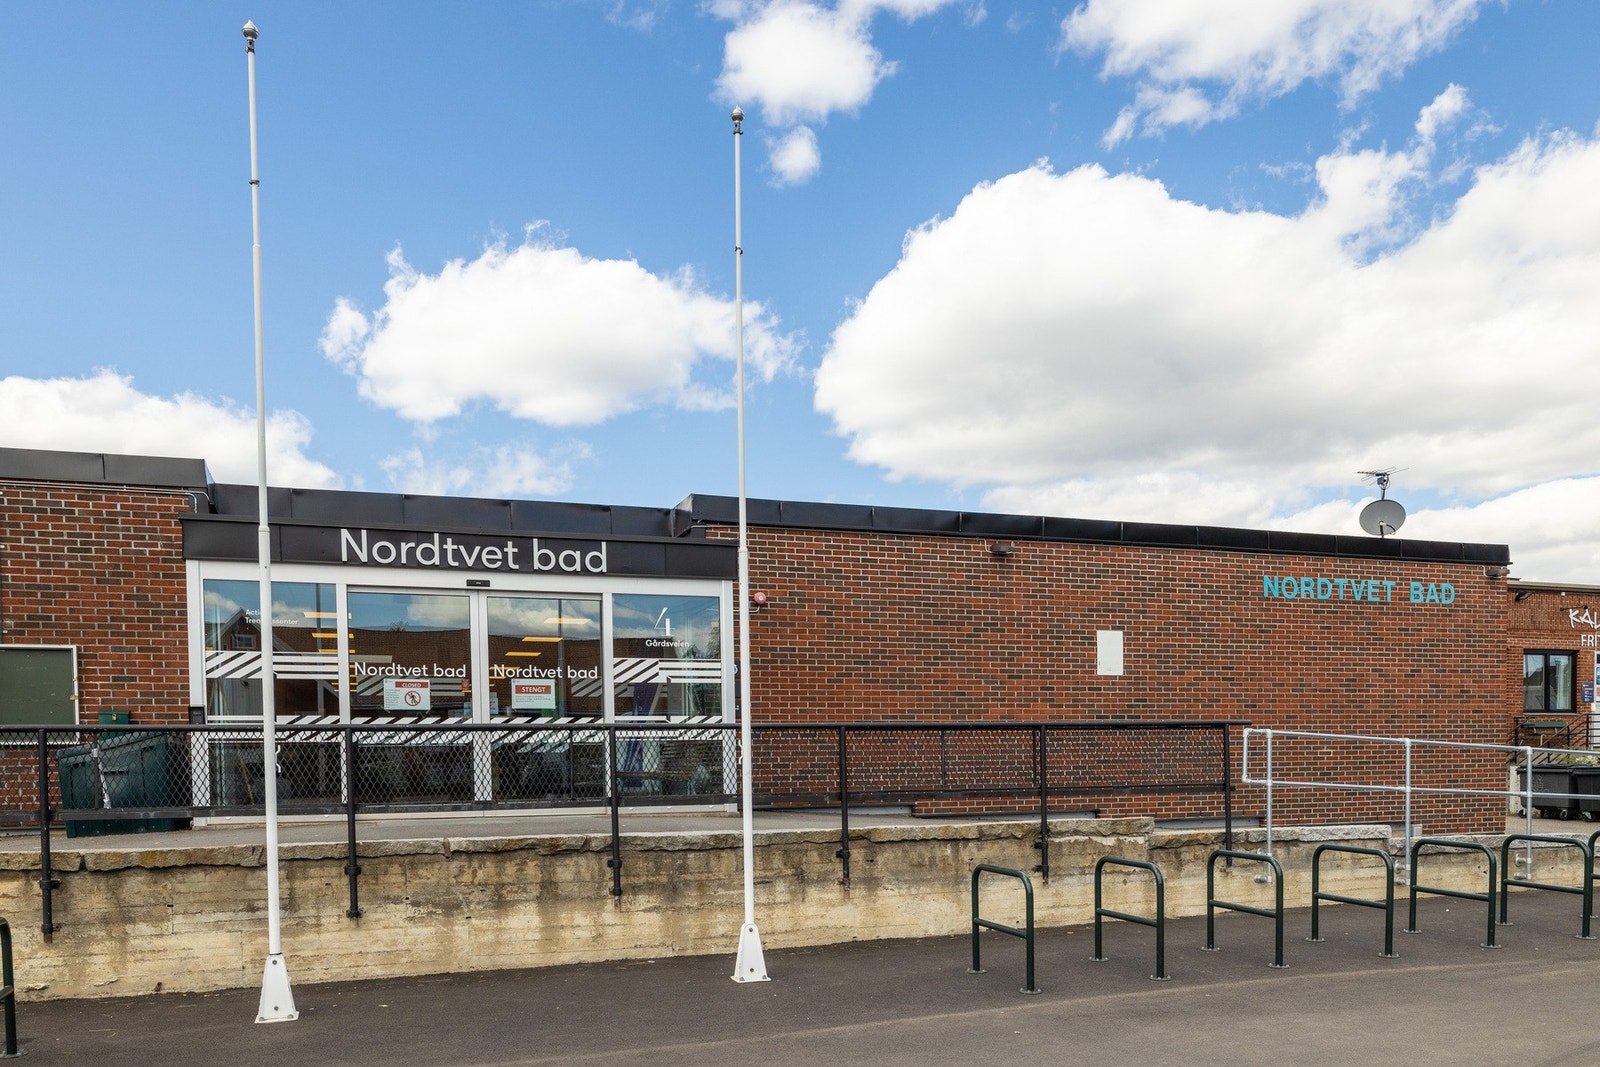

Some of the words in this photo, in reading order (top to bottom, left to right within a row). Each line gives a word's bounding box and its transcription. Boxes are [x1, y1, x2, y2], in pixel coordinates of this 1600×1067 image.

[340, 528, 519, 570] Nordtvet
[532, 538, 608, 573] bad
[1263, 575, 1396, 603] NORDTVET
[1409, 582, 1456, 605] BAD
[654, 607, 675, 637] 4
[645, 639, 690, 648] Gårdsveien
[354, 662, 428, 677] Nordtvet
[433, 663, 466, 678] bad
[493, 664, 563, 678] Nordtvet
[567, 666, 598, 679] bad
